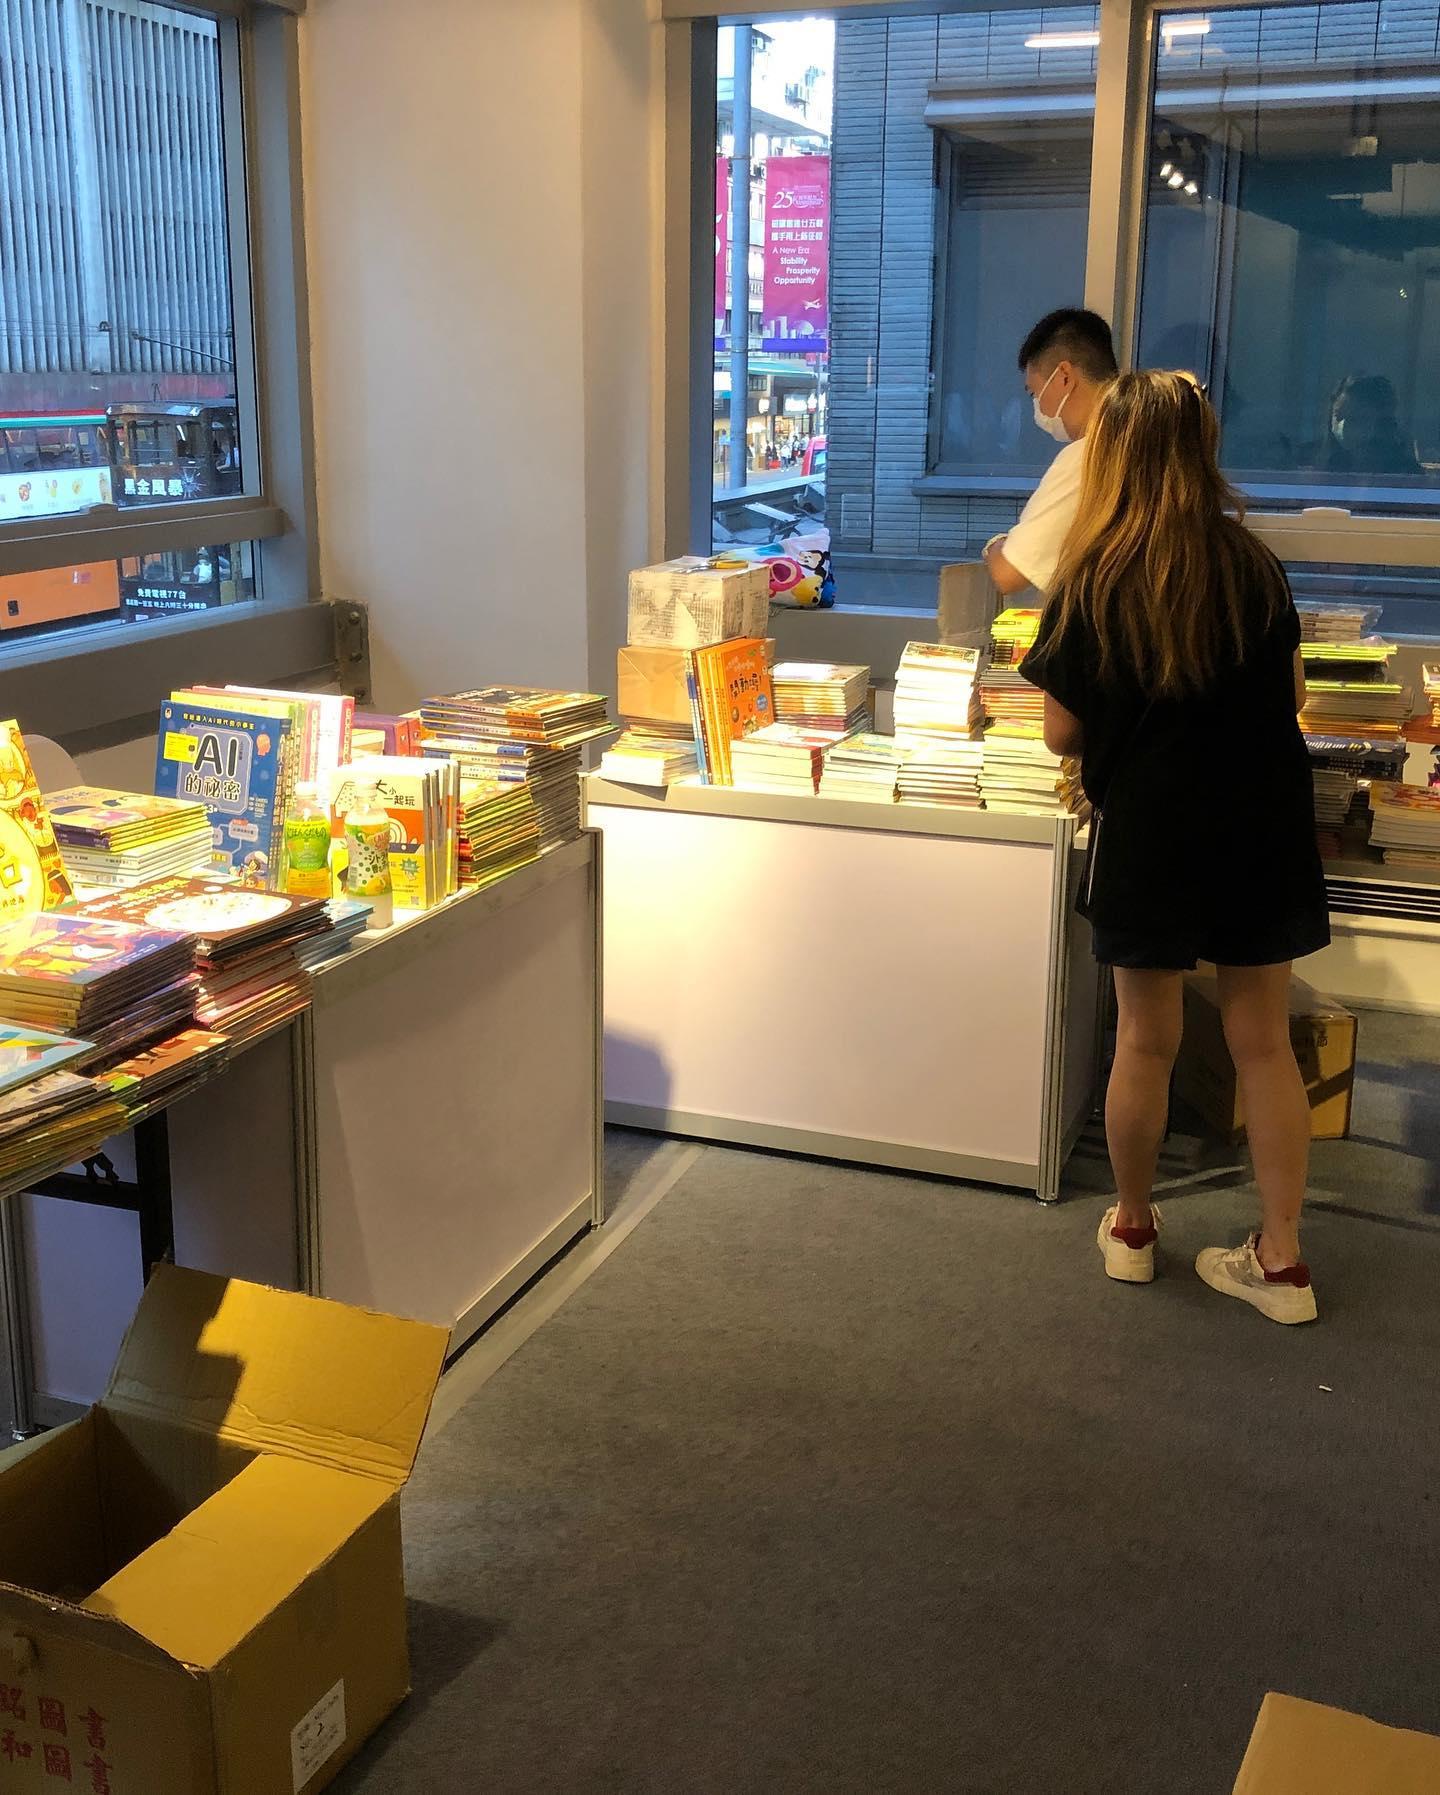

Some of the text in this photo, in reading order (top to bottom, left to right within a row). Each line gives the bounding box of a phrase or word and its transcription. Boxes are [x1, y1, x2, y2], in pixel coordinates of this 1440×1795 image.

[772, 191, 794, 209] 25
[779, 247, 796, 255] New
[780, 256, 808, 266] Stability
[785, 266, 820, 276] Prosperity
[773, 276, 815, 286] Opportunity
[124, 478, 184, 496] 黑金風暴
[193, 733, 239, 778] AI
[383, 795, 416, 807] 一起玩
